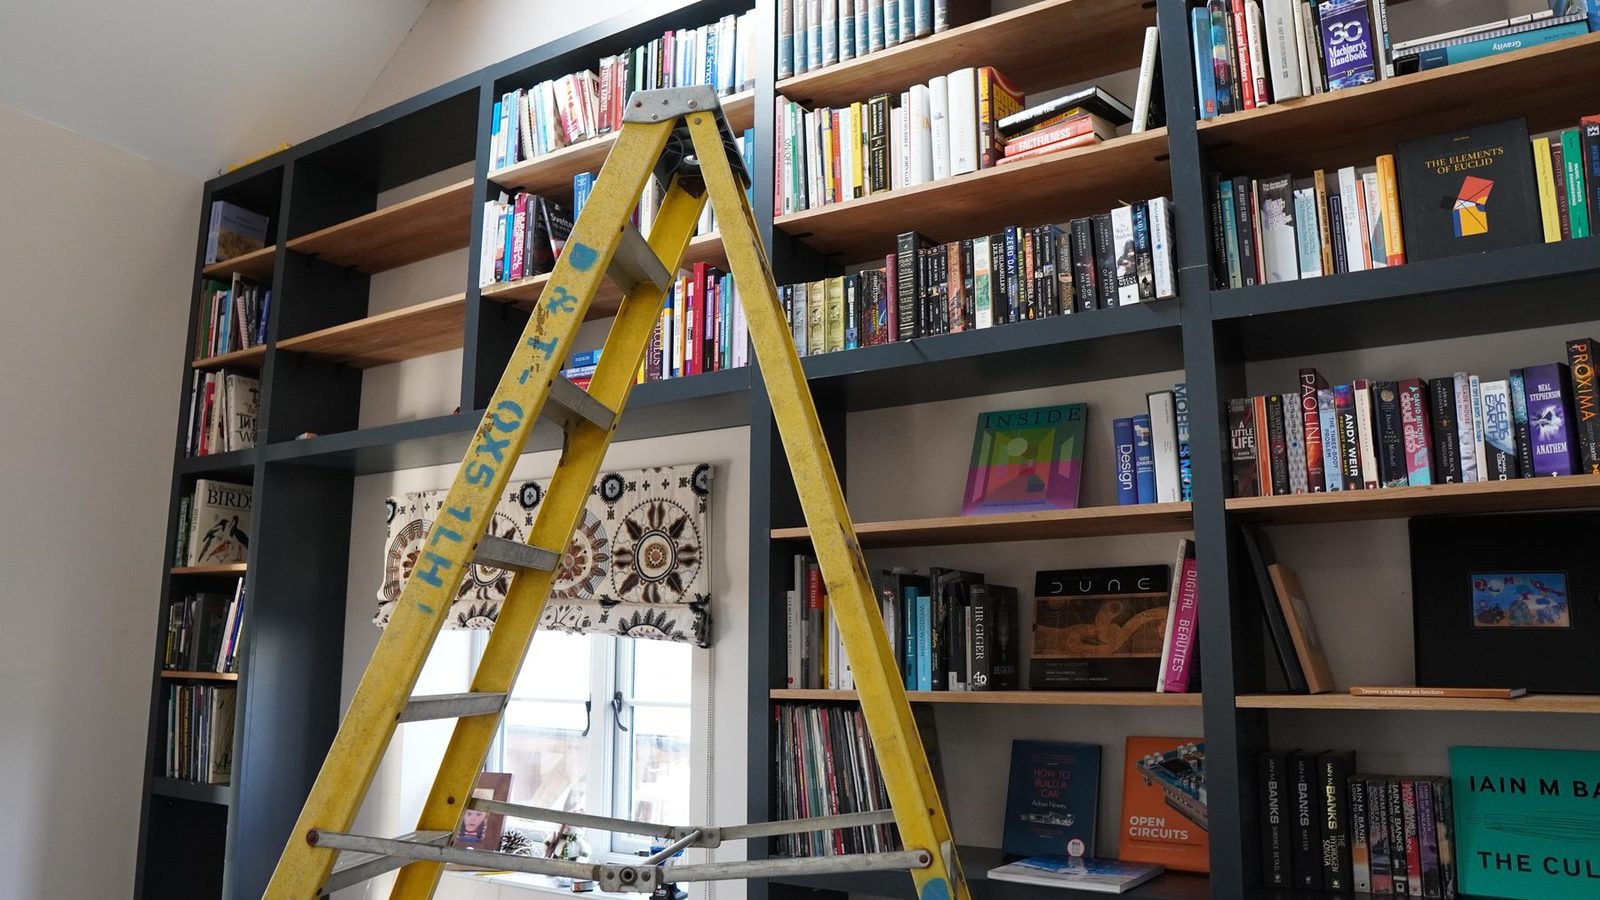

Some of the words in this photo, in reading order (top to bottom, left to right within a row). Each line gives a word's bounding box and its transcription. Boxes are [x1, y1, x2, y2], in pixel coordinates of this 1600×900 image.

[1327, 20, 1363, 45] 30
[1328, 40, 1367, 58] Machinery's
[1492, 41, 1522, 51] Gravity
[1329, 51, 1368, 68] Handbook
[600, 71, 609, 90] LINUX
[600, 90, 608, 113] KERNEL
[1018, 127, 1071, 152] FACTFULNESS
[1424, 158, 1447, 169] THE
[1449, 147, 1504, 164] ELEMENTS
[1437, 166, 1450, 174] OF
[1454, 158, 1493, 173] EUCLID
[1553, 150, 1563, 187] LONGITUDE
[1569, 173, 1577, 206] ENGINEERING
[517, 212, 526, 268] NUMERICAL
[1138, 228, 1146, 250] LANDS
[998, 254, 1006, 294] SILMARILLION
[1007, 259, 1015, 275] DAY
[1102, 268, 1108, 277] OF
[1086, 288, 1092, 297] OF
[1107, 270, 1115, 293] SHARDS
[652, 320, 662, 366] ALCULUS
[1537, 383, 1552, 392] NEAL
[1571, 343, 1596, 422] PROXIMA
[1400, 391, 1416, 424] cloud
[1413, 393, 1422, 415] DAVID
[1436, 380, 1444, 415] TCHAIKOVSKY
[1529, 390, 1561, 402] STEPHENSON
[984, 407, 1082, 429] INSIDE
[1174, 384, 1189, 441] MORE
[1300, 373, 1320, 445] PAOLINI
[1484, 393, 1499, 440] EARTH
[1494, 392, 1510, 441] SEEDS
[1231, 427, 1254, 437] LITTLE
[1338, 416, 1346, 443] PROJECT
[1344, 413, 1355, 448] ANDY
[1404, 424, 1419, 454] atlas
[1415, 415, 1425, 449] MITCHELL
[1178, 442, 1191, 457] IS
[1232, 436, 1254, 449] LIFE
[1324, 428, 1332, 458] PROBLEM
[1329, 429, 1339, 469] THREE-BODY
[1536, 441, 1568, 455] ANATHEM
[1118, 444, 1133, 491] Design
[1348, 449, 1359, 477] WEIR
[1180, 459, 1194, 502] MOR
[1050, 577, 1151, 594] DUNE
[1181, 569, 1198, 612] DIGITAL
[975, 606, 984, 622] HR
[975, 624, 985, 660] GIGER
[1171, 619, 1190, 673] BEAUTIES
[1033, 768, 1056, 777] HOW
[1058, 769, 1071, 779] TO
[1326, 762, 1334, 777] IAIN
[1328, 777, 1334, 785] M
[1033, 778, 1059, 789] BUILD
[1060, 780, 1068, 789] A
[1040, 789, 1059, 799] CAR
[1356, 783, 1364, 802] IAIN
[1392, 784, 1400, 803] IAIN
[1470, 775, 1527, 794] IAIN
[1539, 778, 1560, 796] M
[1031, 799, 1049, 808] Adrian
[1298, 782, 1310, 826] BANKS
[1325, 785, 1338, 830] BANKS
[1352, 803, 1358, 813] TO
[1357, 804, 1364, 814] M.
[1394, 805, 1401, 815] M.
[1129, 816, 1166, 827] OPEN
[1353, 813, 1361, 848] WINDWARD
[1358, 816, 1367, 849] BANKS
[1129, 827, 1189, 840] CIRCUITS
[1271, 825, 1279, 849] SURFACE
[1337, 833, 1345, 848] THE
[1394, 817, 1404, 852] BANKS
[1273, 851, 1281, 872] DETAIL
[1322, 839, 1331, 866] SONATA
[1329, 835, 1339, 872] HYDROGEN
[1477, 850, 1532, 873] THE
[1543, 856, 1600, 879] CUL
